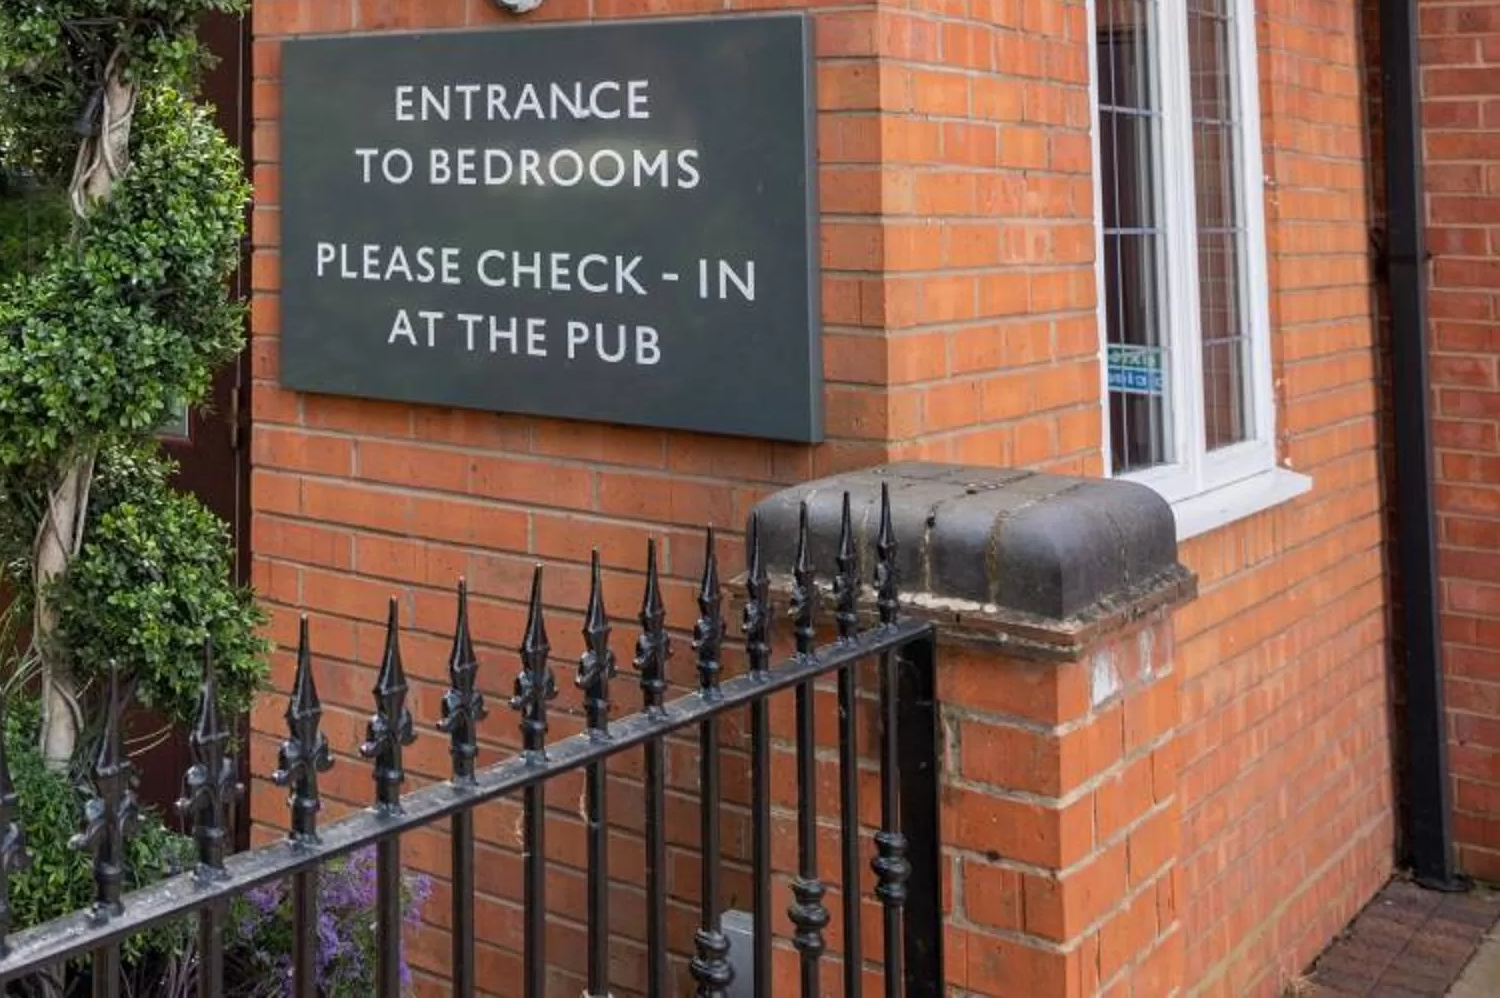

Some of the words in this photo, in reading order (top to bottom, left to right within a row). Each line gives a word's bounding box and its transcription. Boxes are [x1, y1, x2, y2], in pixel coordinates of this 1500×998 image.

[395, 80, 650, 121] ENTRANCE
[355, 148, 413, 184] TO
[429, 148, 701, 189] BEDROOMS
[317, 242, 461, 285] PLEASE
[387, 309, 444, 347] AT
[457, 313, 547, 357] THE
[567, 321, 661, 365] PUB
